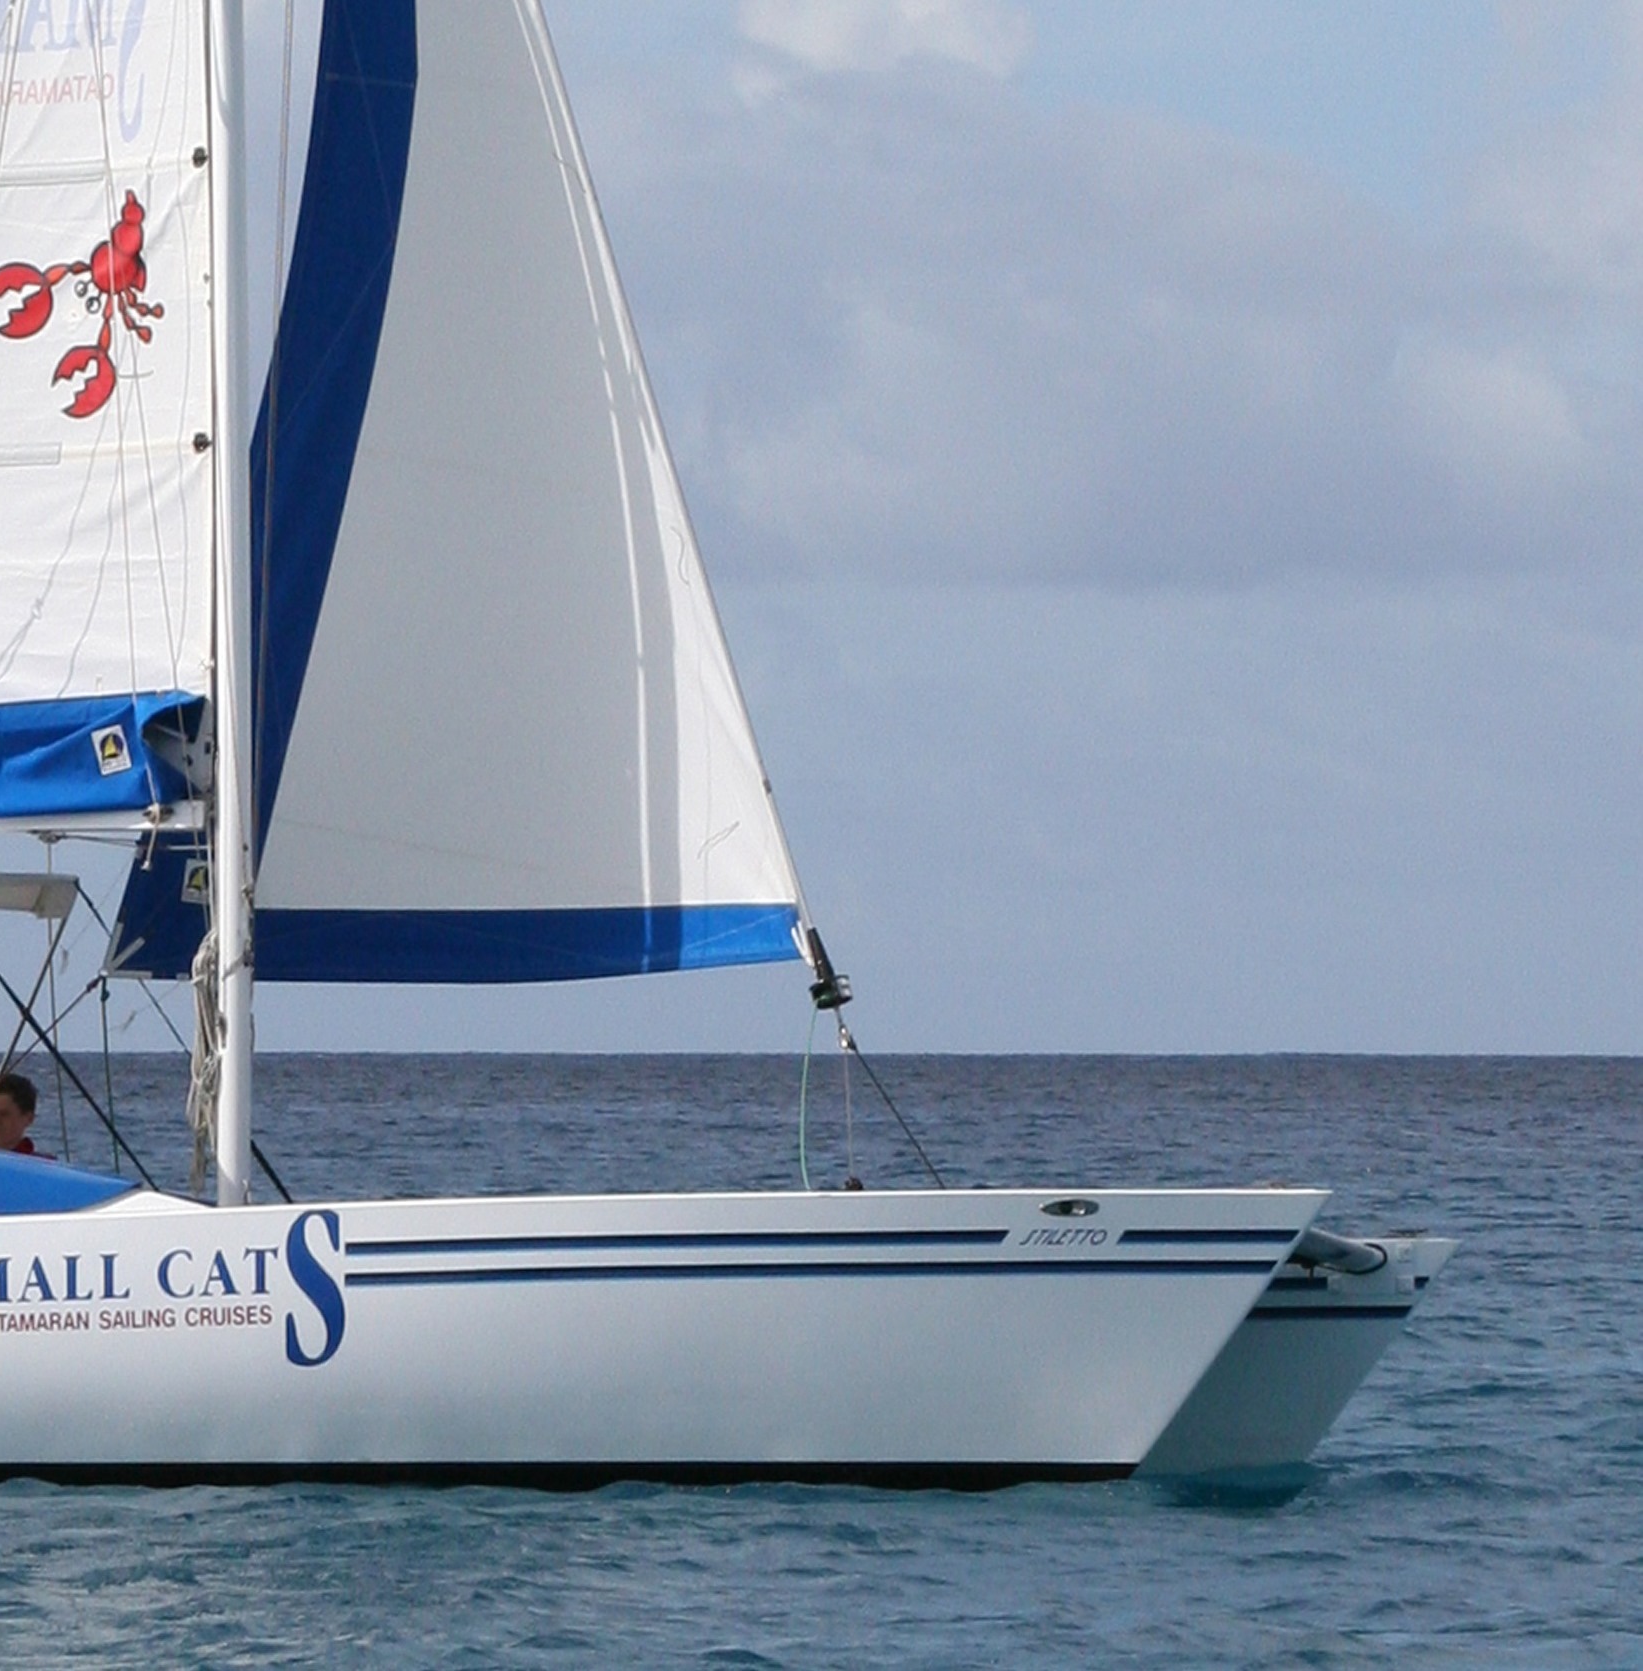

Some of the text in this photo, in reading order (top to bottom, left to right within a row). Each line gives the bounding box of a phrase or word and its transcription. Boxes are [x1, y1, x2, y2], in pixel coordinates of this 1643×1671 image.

[1018, 1228, 1108, 1246] STILETTO
[158, 1209, 346, 1367] CATS
[99, 1308, 176, 1329] SAILING
[185, 1304, 273, 1327] CRUISES
